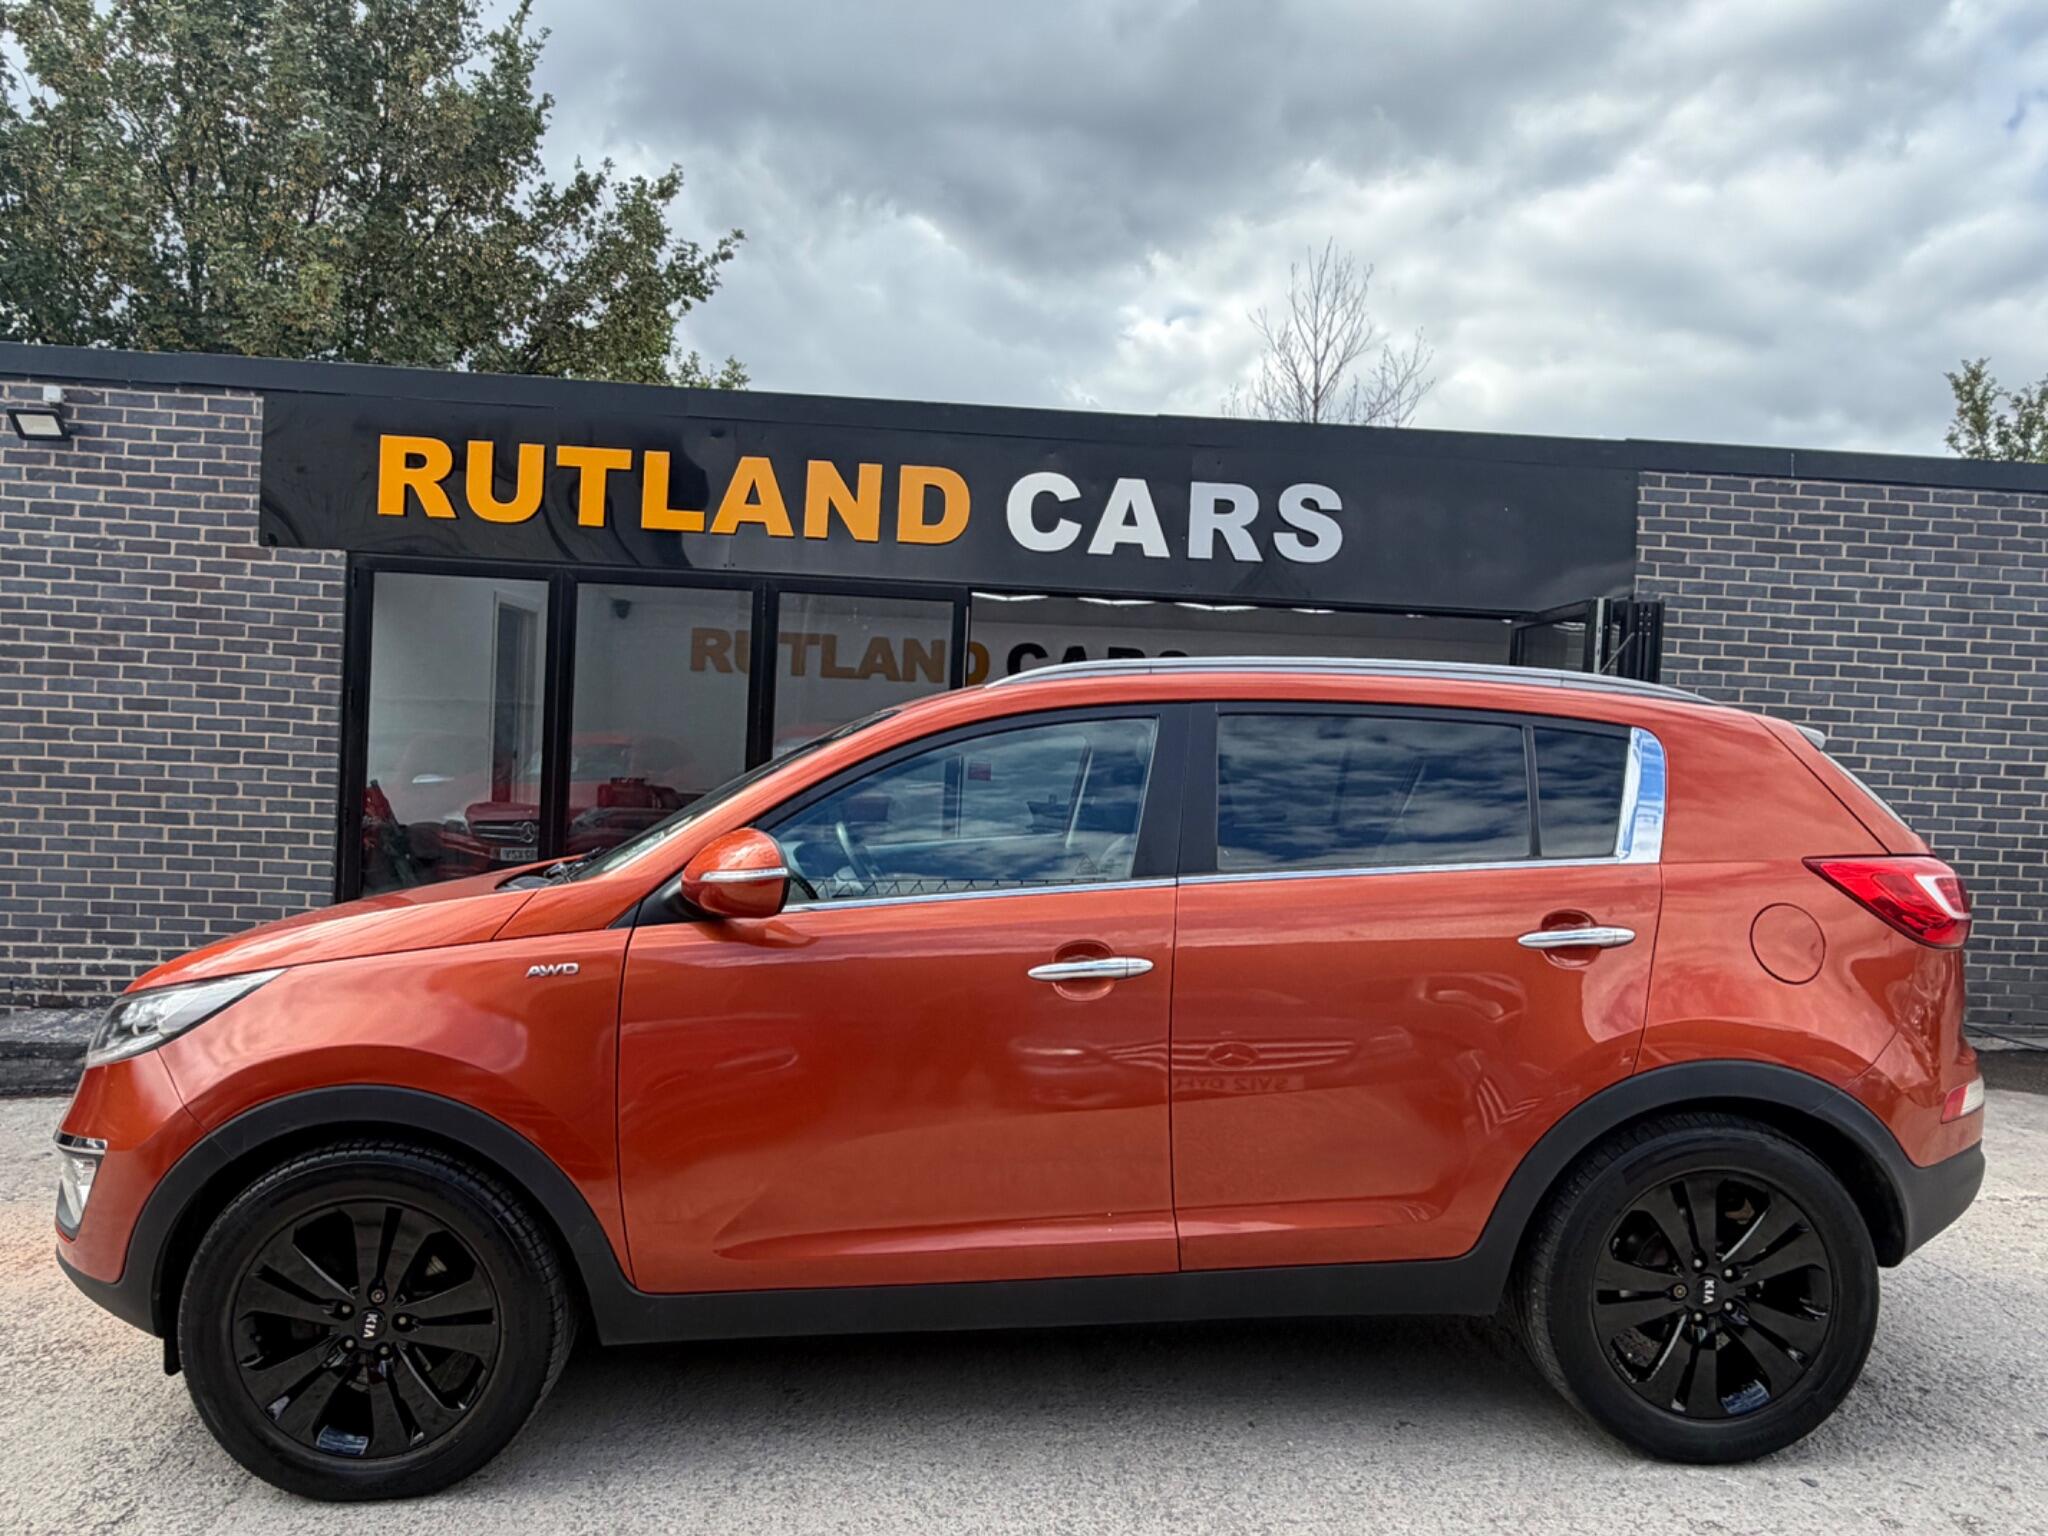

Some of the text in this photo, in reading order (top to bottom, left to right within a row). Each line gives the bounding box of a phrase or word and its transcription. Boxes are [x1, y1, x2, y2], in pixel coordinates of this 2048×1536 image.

[377, 434, 1344, 564] RUTLAND CARS
[525, 962, 579, 978] AWD
[1702, 1280, 1715, 1304] KIA
[363, 1313, 378, 1338] KIA
